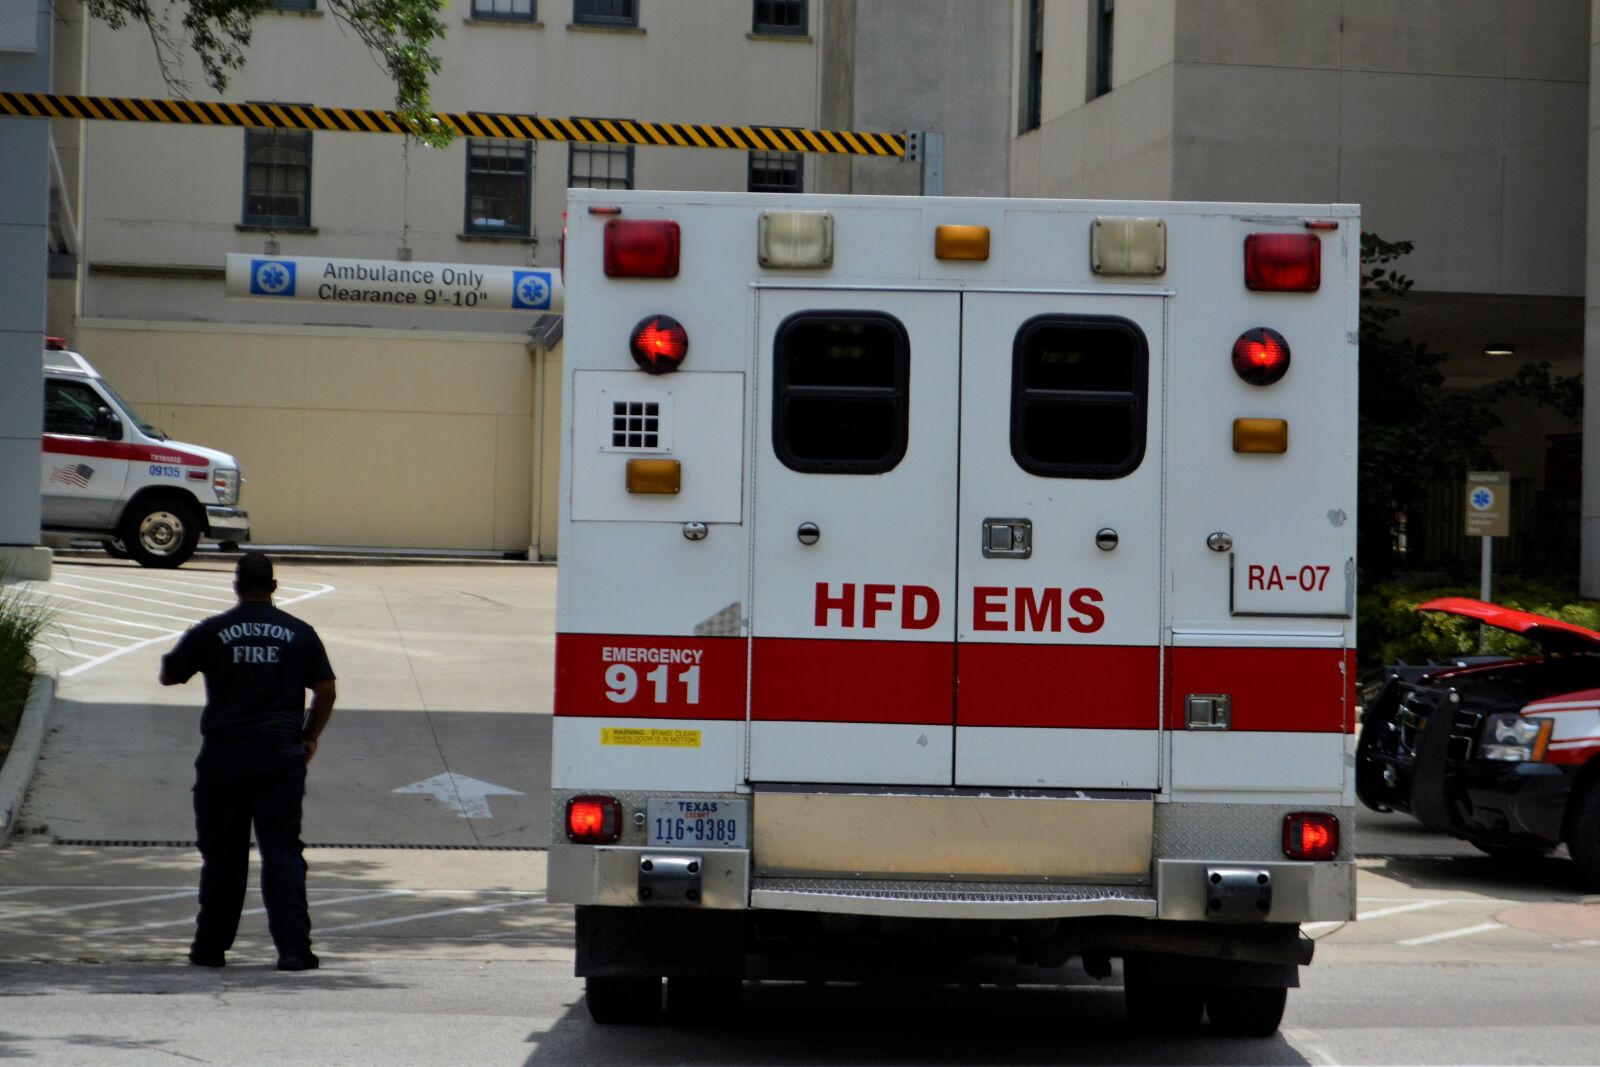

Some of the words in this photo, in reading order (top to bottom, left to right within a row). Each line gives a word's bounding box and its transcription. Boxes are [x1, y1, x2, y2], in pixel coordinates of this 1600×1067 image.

[323, 262, 434, 284] Ambulance
[441, 268, 484, 291] Only
[318, 283, 417, 304] Clearance
[149, 465, 180, 478] 09135
[1248, 564, 1330, 592] RA-07
[815, 582, 940, 630] HFD
[973, 586, 1105, 634] EMS
[217, 622, 295, 644] HOUSTON
[232, 646, 280, 663] FIRE
[602, 646, 703, 664] EMERGENCY
[605, 663, 701, 704] 911
[678, 802, 717, 812] TEXAS
